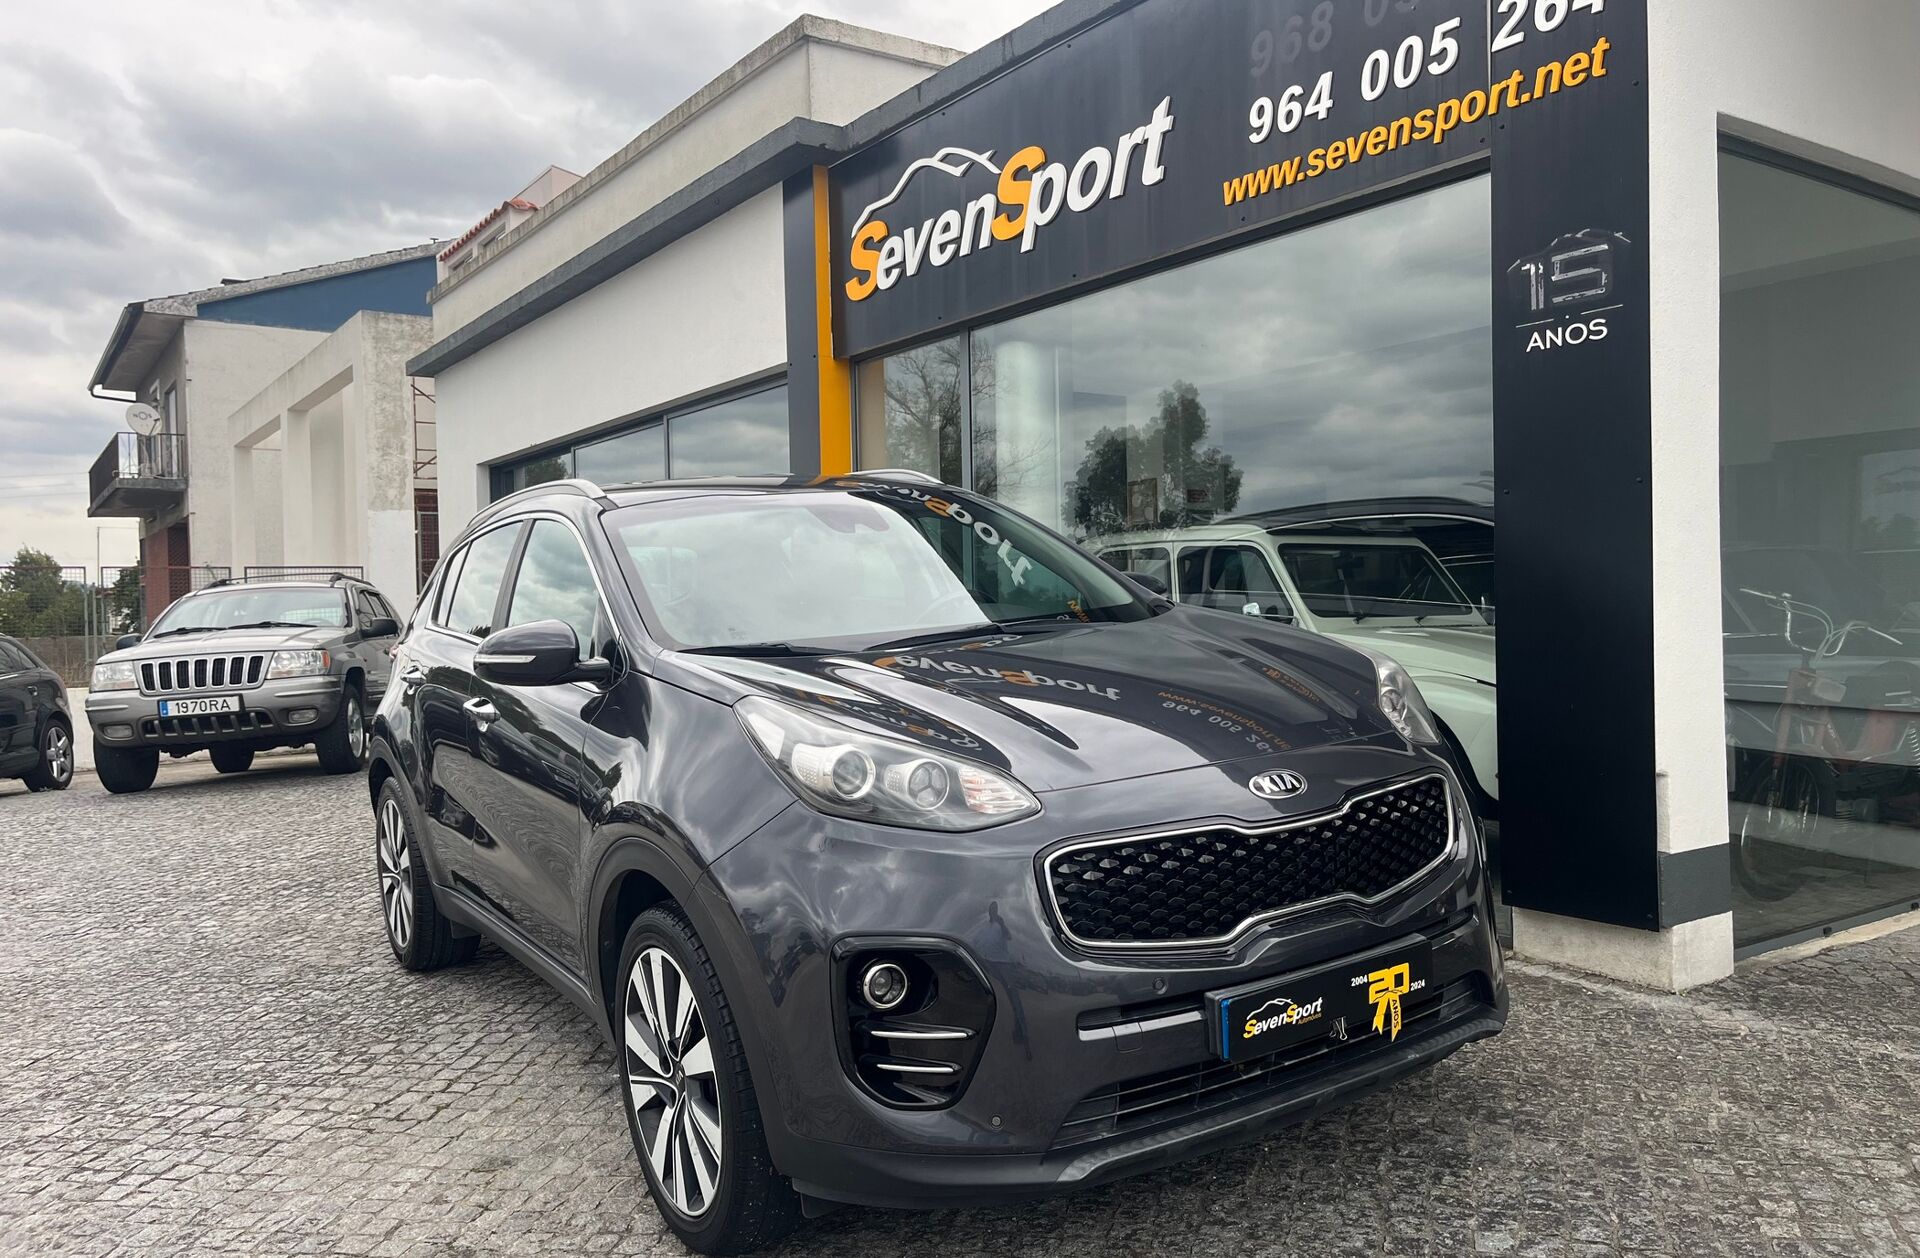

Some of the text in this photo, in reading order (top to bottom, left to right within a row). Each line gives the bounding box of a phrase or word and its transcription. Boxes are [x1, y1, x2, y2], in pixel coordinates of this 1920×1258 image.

[1248, 72, 1334, 144] 964
[1361, 17, 1461, 101] 005
[1222, 37, 1611, 206] www.sevensport.net
[845, 96, 1174, 301] SevenSport
[1525, 318, 1609, 353] ANOS
[175, 699, 231, 714] 1970RA
[1256, 773, 1301, 794] KIA
[1350, 974, 1368, 987] 2004
[1410, 979, 1426, 991] 2024
[1243, 997, 1323, 1039] SevenSport
